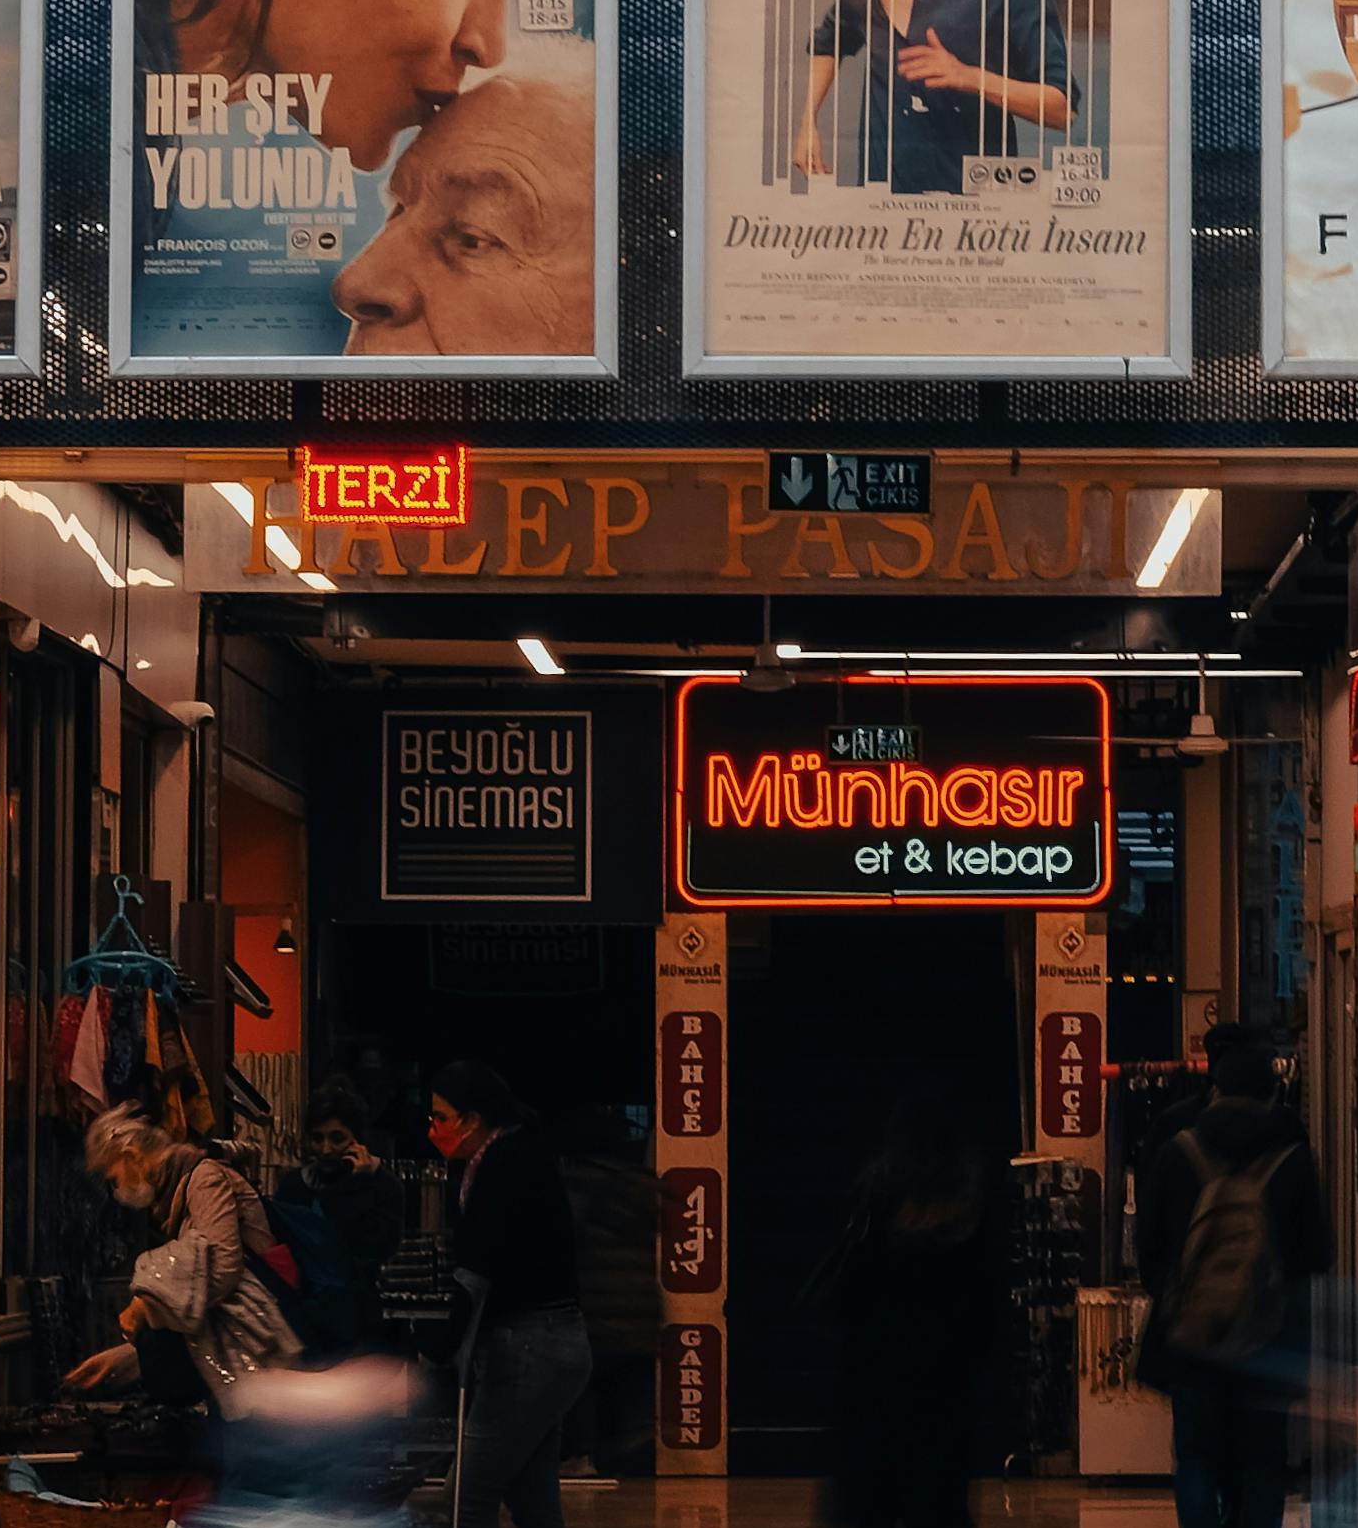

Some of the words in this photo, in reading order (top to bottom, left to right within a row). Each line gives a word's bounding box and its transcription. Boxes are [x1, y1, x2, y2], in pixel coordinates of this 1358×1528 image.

[145, 72, 228, 136] HER
[244, 72, 333, 145] ŞEY
[145, 147, 358, 210] YOLUNDA
[157, 239, 227, 254] FRANÇOIS
[724, 215, 889, 259] Dünyanın
[900, 218, 944, 252] En
[954, 216, 1031, 254] Kötü
[1039, 216, 1147, 256] İnsanı
[308, 455, 452, 509] TERZİ
[864, 462, 920, 484] EXIT
[400, 721, 573, 777] BEYOĞLU
[707, 753, 1085, 830] Münhasır
[853, 840, 891, 876] et
[902, 838, 933, 875] &
[946, 838, 1075, 884] kebap
[679, 1015, 704, 1135] BAHÇE
[1059, 1016, 1084, 1136] BAHÇE
[678, 1329, 704, 1446] GARDEN
